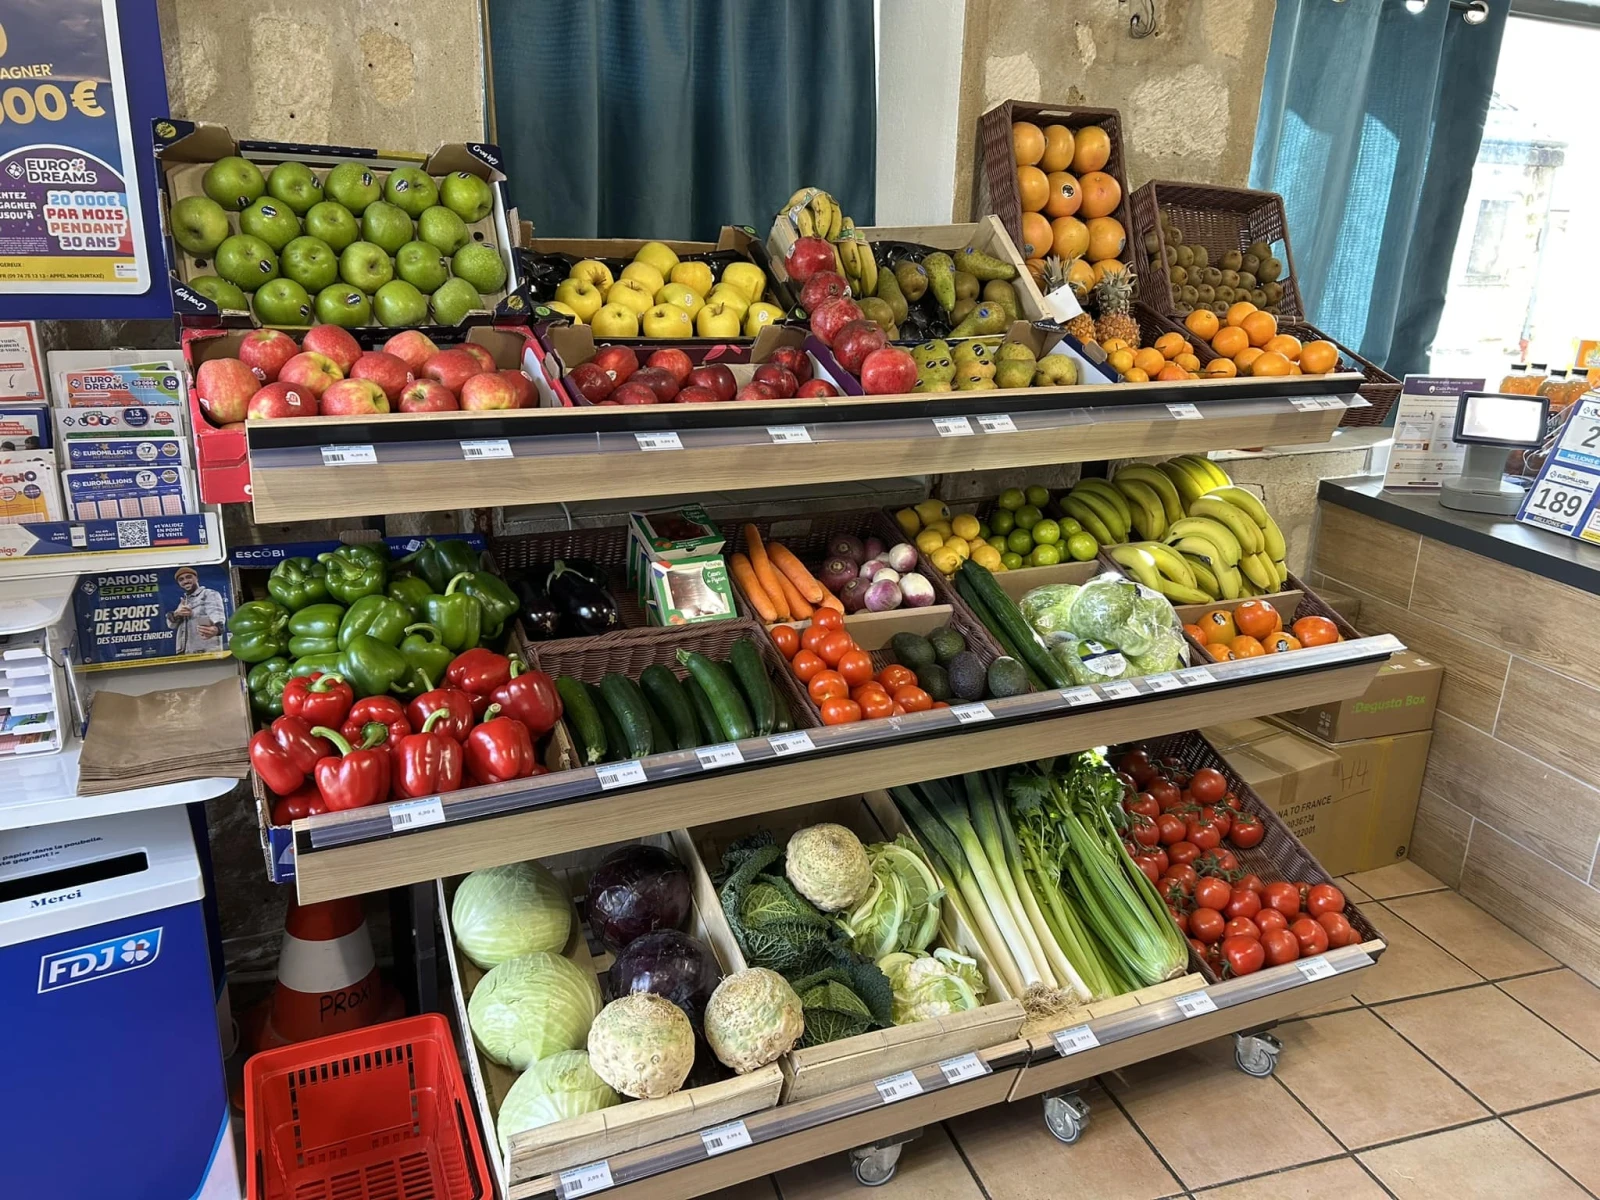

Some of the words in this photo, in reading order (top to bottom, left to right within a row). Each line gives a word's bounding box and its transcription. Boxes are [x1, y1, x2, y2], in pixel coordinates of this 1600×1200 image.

[0, 84, 68, 125] 00
[70, 80, 106, 117] €
[27, 160, 70, 171] EURO
[29, 171, 96, 183] DREAMS
[51, 194, 71, 205] 20
[46, 208, 79, 219] PAR
[82, 209, 124, 220] MOIS
[51, 222, 124, 234] PENDANT
[61, 236, 82, 248] 30
[85, 236, 117, 248] ANS
[84, 376, 112, 384] EURO
[85, 383, 129, 391] DREAMS
[83, 448, 133, 457] EUROMILLIONS
[82, 478, 133, 487] EUROMILLIONS
[1533, 488, 1583, 517] 189
[98, 573, 158, 587] PARIONS
[101, 584, 157, 595] SPORT
[94, 608, 110, 622] DE
[112, 604, 160, 620] SPORTS
[95, 622, 112, 636] DE
[114, 619, 151, 634] PARIS
[97, 636, 110, 645] DES
[111, 634, 142, 643] SERVICES
[142, 631, 173, 641] ENRICHIS
[1290, 805, 1301, 816] TO
[1301, 795, 1332, 812] FRANCE
[3, 851, 31, 861] papier
[32, 846, 53, 854] dans
[13, 852, 49, 865] gagnant
[31, 889, 82, 909] Merci
[49, 946, 115, 983] FDJ
